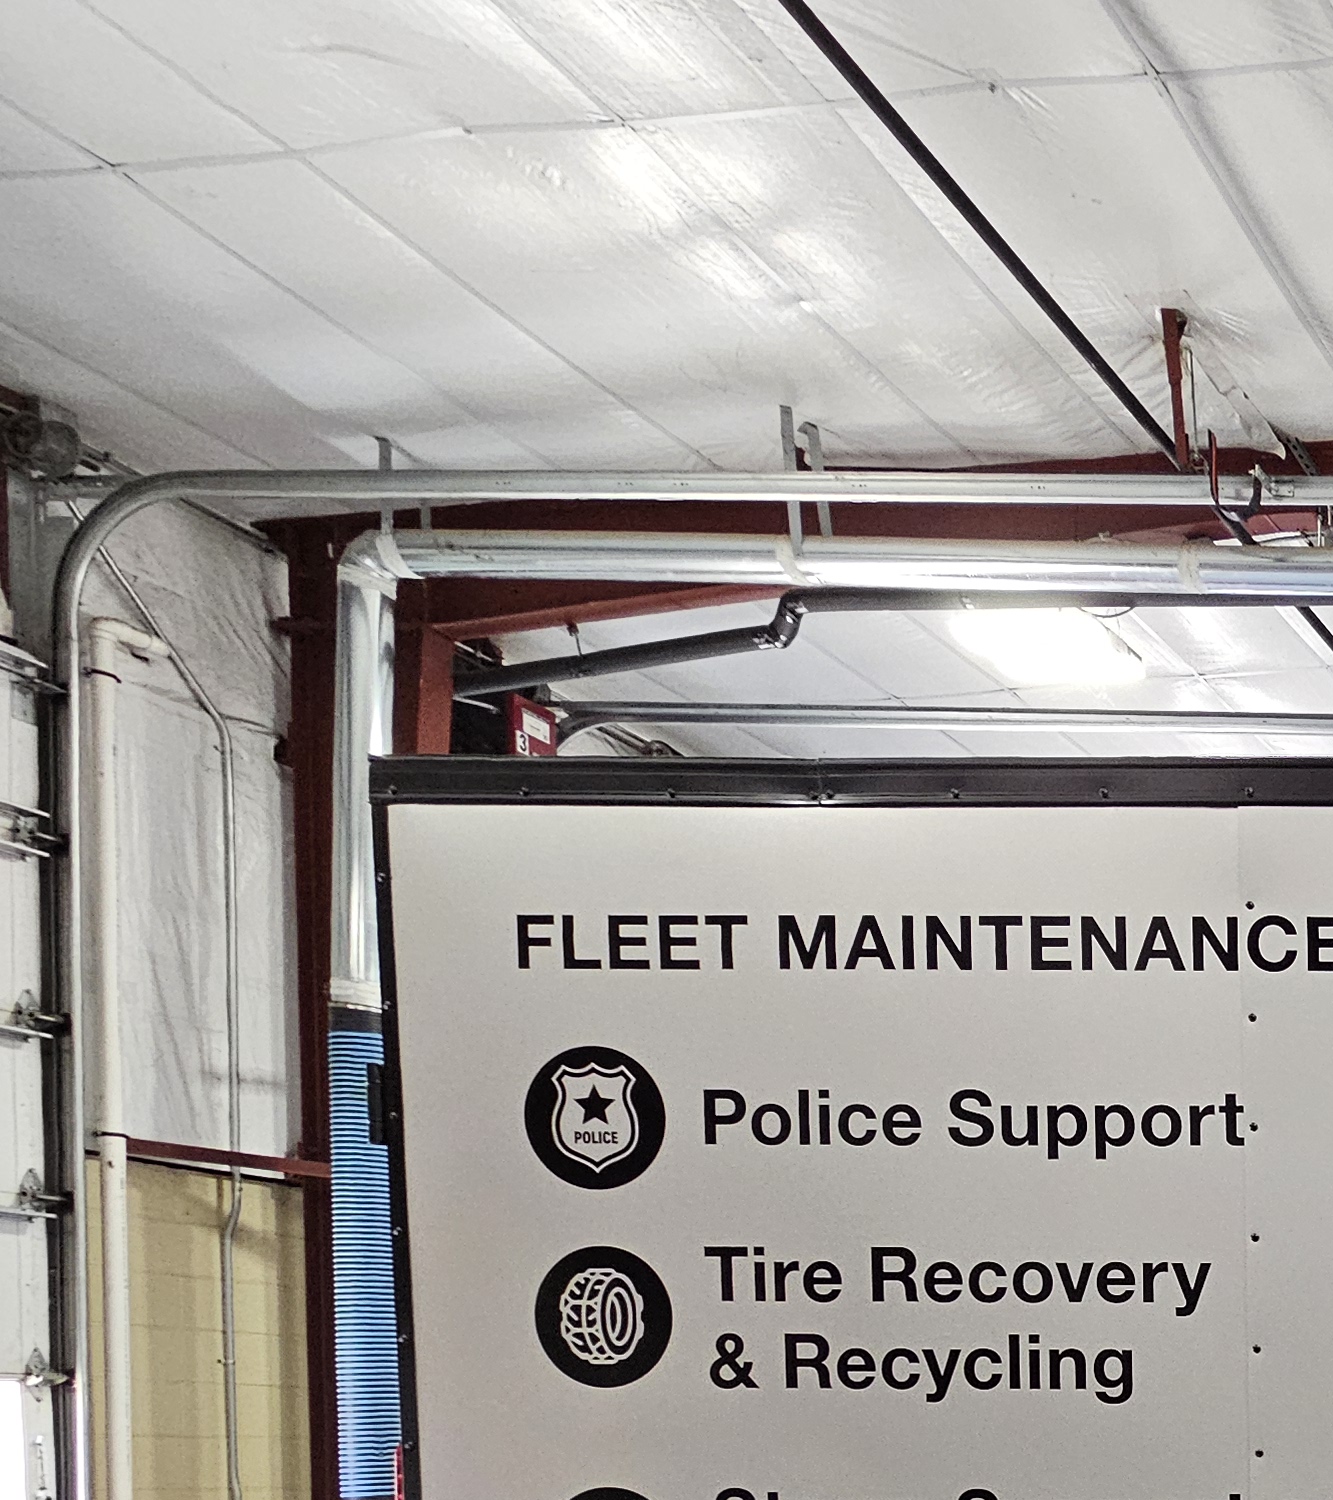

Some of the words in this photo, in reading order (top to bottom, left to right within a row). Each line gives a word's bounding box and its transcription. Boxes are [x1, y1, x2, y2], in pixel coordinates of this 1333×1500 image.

[518, 734, 527, 752] 3
[516, 914, 749, 970] FLEET
[574, 1131, 618, 1144] POLICE
[702, 1089, 922, 1147] Police
[947, 1088, 1245, 1160] Support
[703, 1245, 843, 1303] Tire
[870, 1246, 1212, 1317] Recovery
[709, 1332, 760, 1390] &
[784, 1333, 1134, 1405] Recycling
